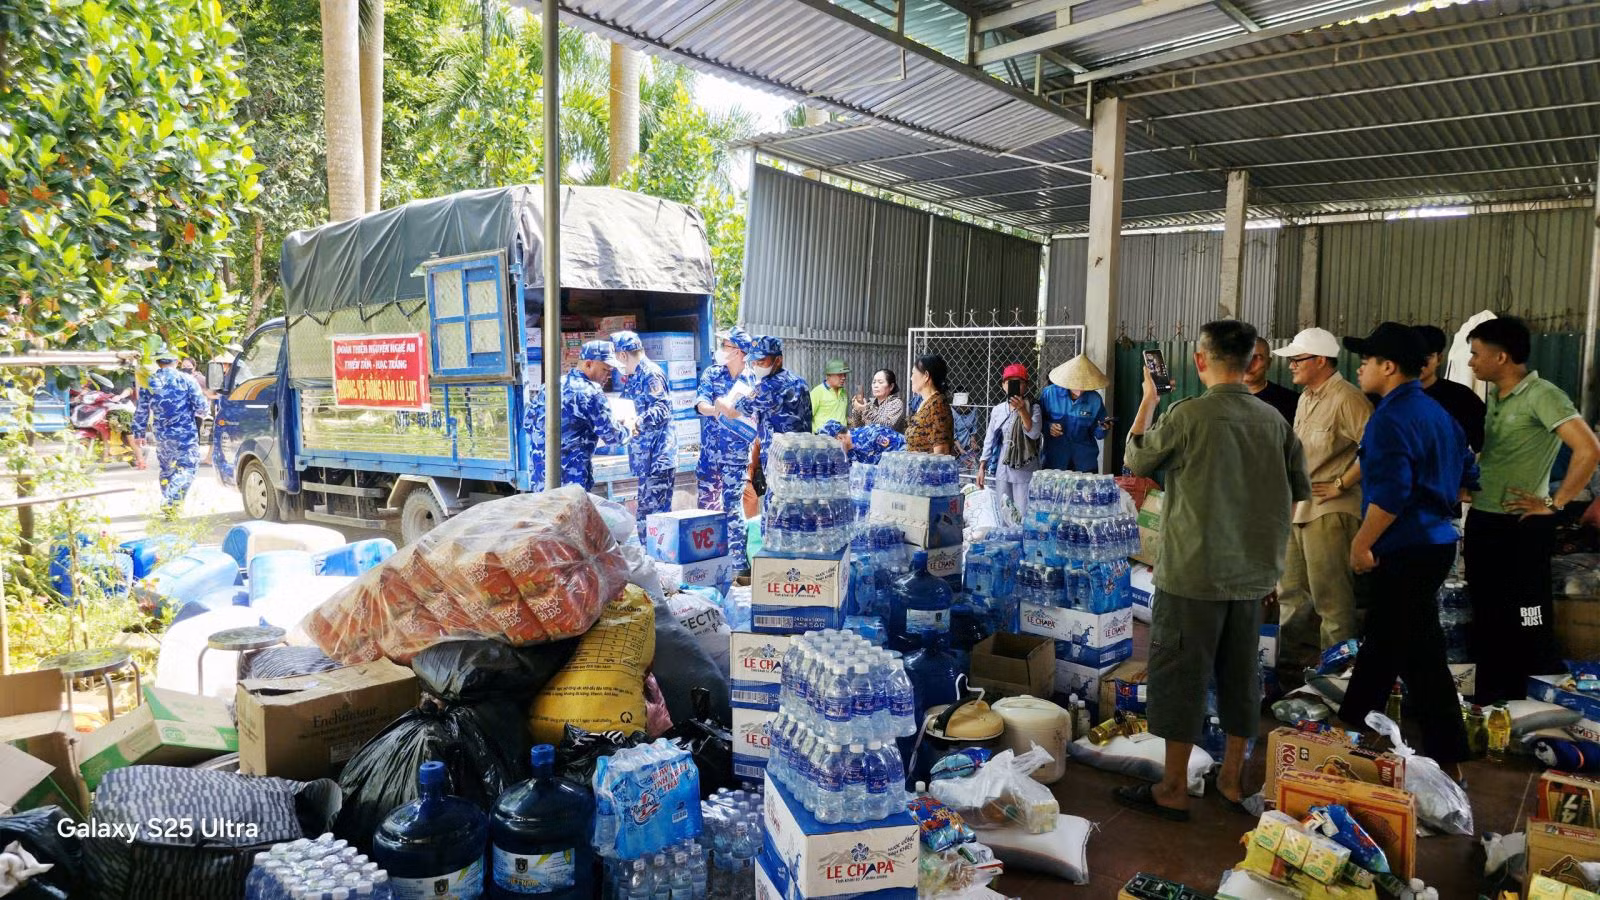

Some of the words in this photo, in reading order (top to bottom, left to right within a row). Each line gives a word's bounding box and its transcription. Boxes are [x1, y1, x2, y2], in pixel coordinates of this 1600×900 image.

[767, 582, 780, 593] LE
[783, 583, 821, 597] CHAPA
[1027, 615, 1034, 623] LE
[1035, 617, 1056, 628] CHAPA
[1521, 615, 1543, 627] JUST
[744, 657, 756, 668] LE
[759, 659, 782, 673] CHA
[746, 733, 757, 744] LE
[1301, 749, 1309, 760] 65
[827, 865, 843, 880] LE
[847, 860, 895, 881] CHAPA
